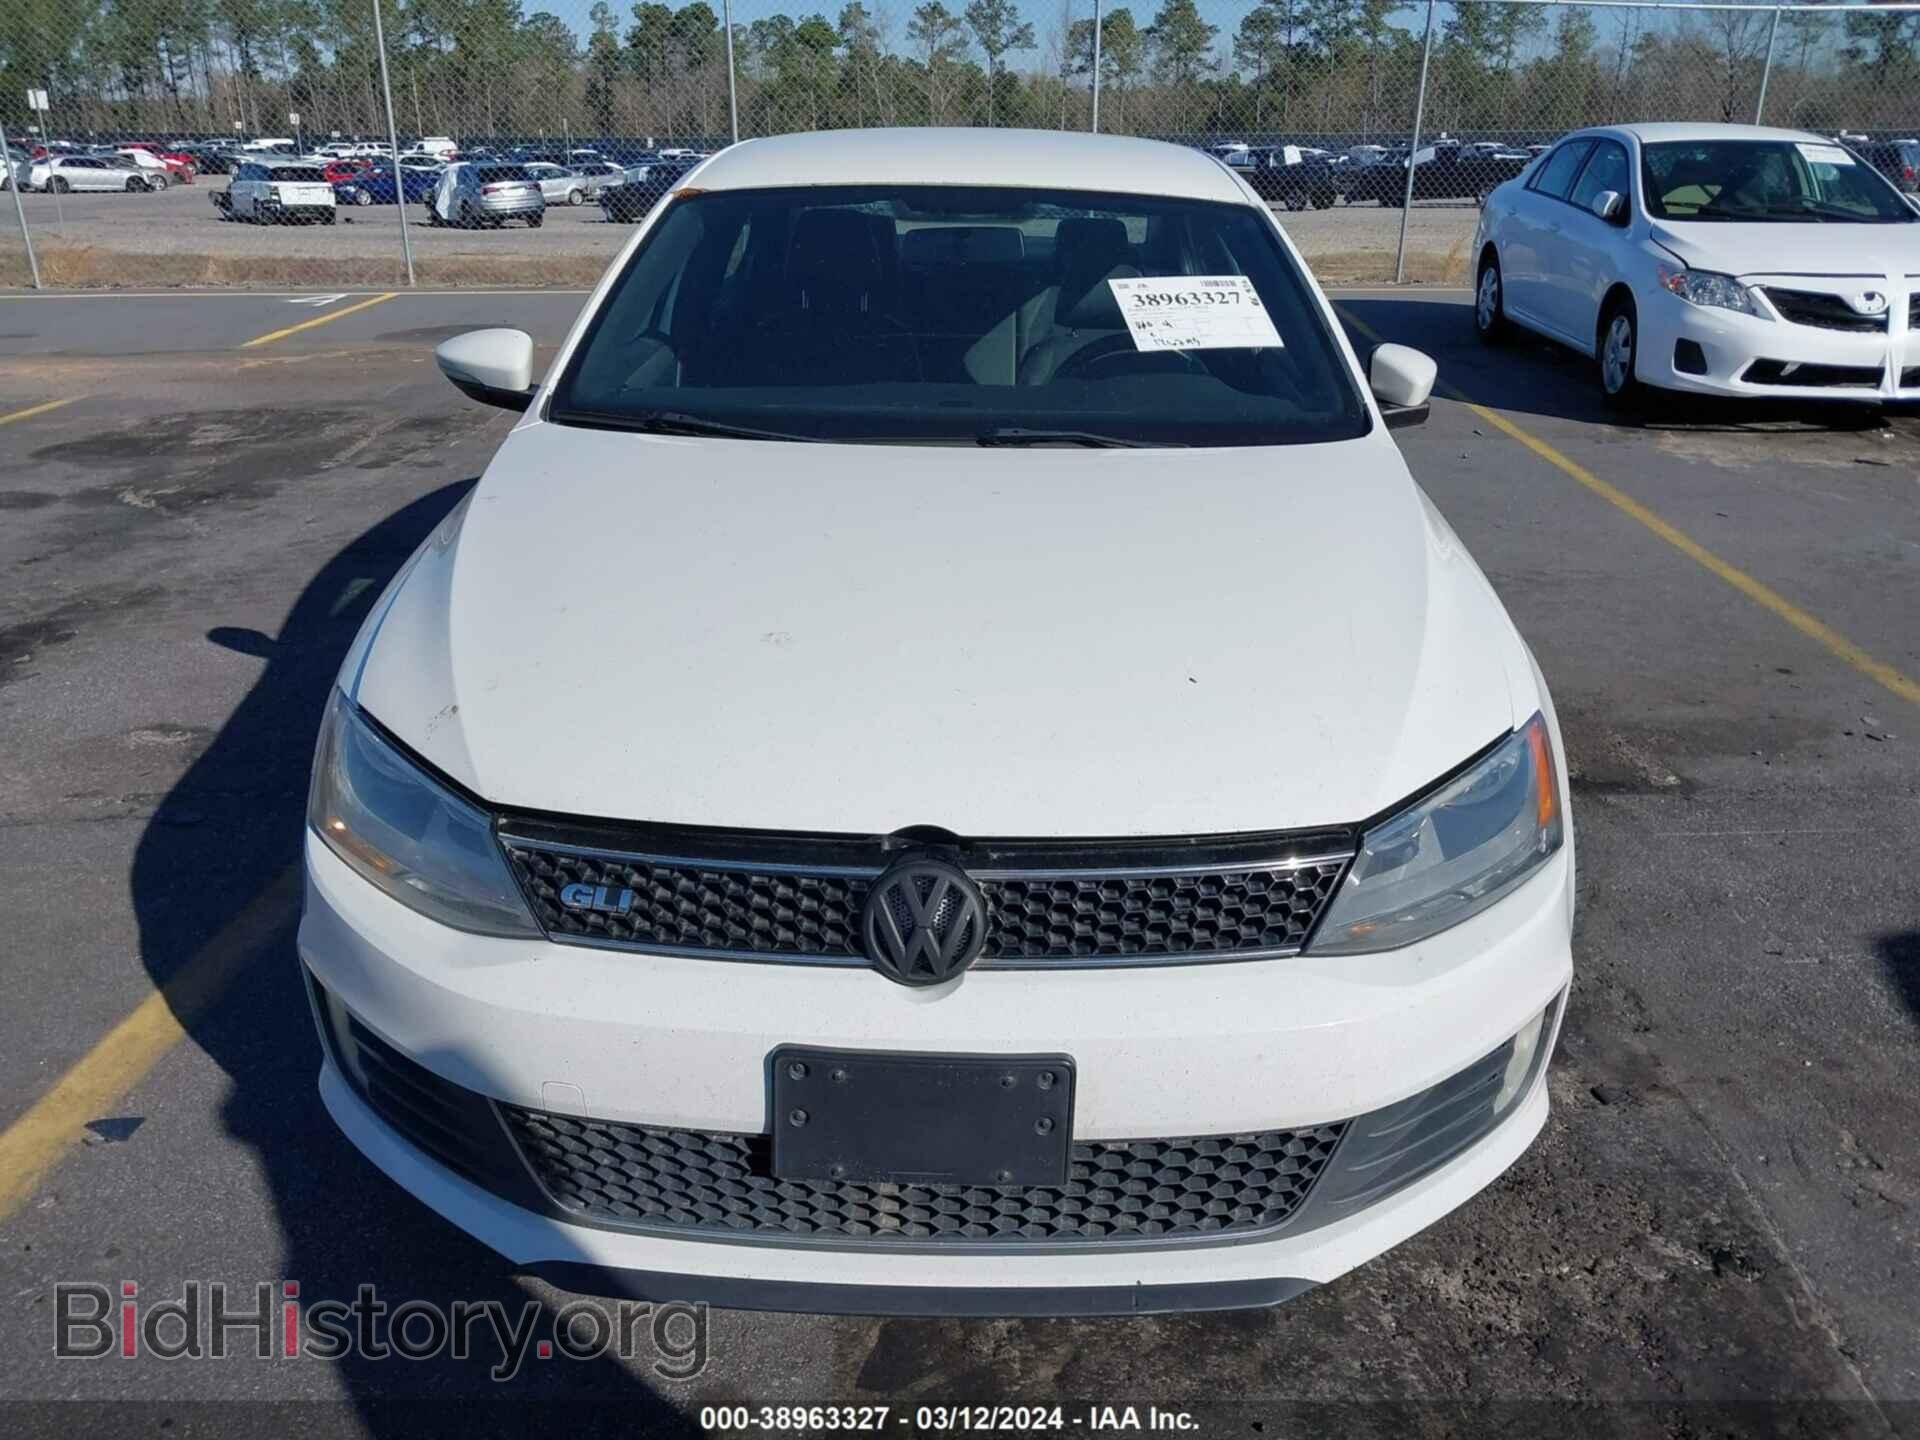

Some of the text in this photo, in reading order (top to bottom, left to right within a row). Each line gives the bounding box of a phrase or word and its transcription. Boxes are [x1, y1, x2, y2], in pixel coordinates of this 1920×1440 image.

[1132, 291, 1240, 308] 38963327
[559, 882, 633, 915] GLI
[868, 866, 980, 982] VW
